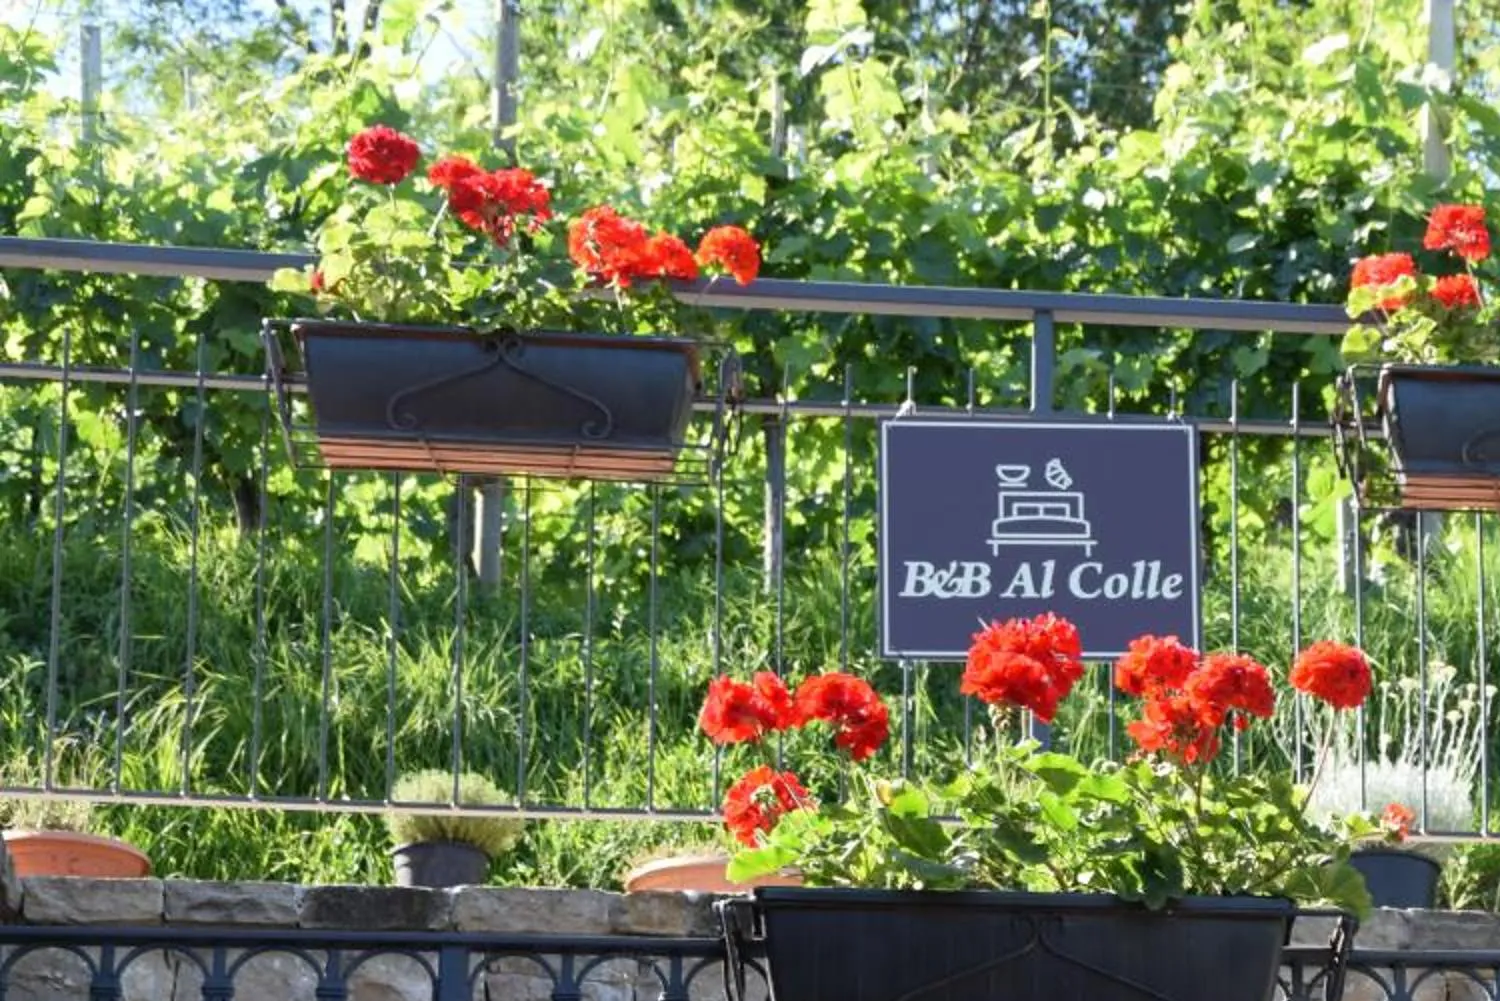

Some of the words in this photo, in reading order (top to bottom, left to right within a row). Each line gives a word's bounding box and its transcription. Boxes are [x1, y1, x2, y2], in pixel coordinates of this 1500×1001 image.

[898, 560, 992, 599] B&B
[1000, 559, 1055, 598] Al
[1068, 559, 1183, 599] Colle
